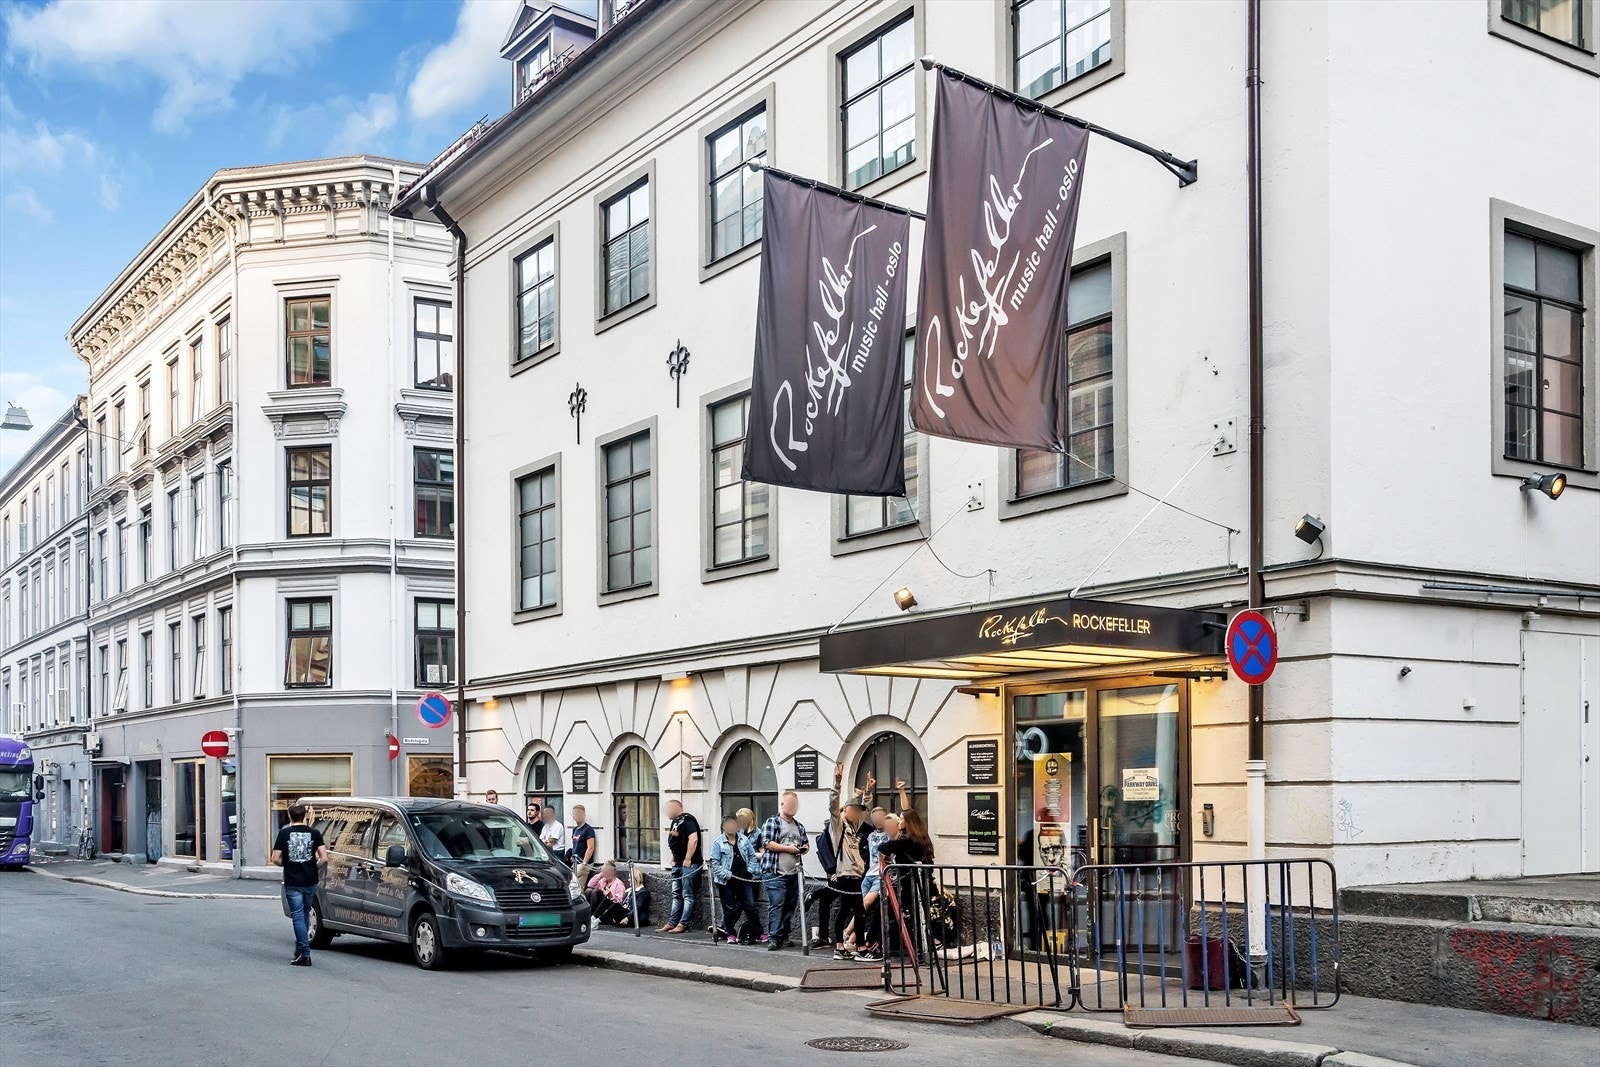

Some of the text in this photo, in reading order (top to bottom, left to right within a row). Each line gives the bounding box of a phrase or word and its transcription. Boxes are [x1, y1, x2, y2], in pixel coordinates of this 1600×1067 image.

[923, 137, 1054, 419] Rockefeller
[1010, 251, 1040, 311] music
[1035, 209, 1058, 251] hall
[1059, 158, 1078, 201] oslo
[770, 224, 878, 471] Rockefeller
[851, 321, 878, 373] music
[869, 285, 889, 320] hall
[886, 241, 902, 278] oslo
[979, 607, 1151, 644] Rockefeller ROCKEFELLER
[334, 906, 398, 929] www.openscene.no
